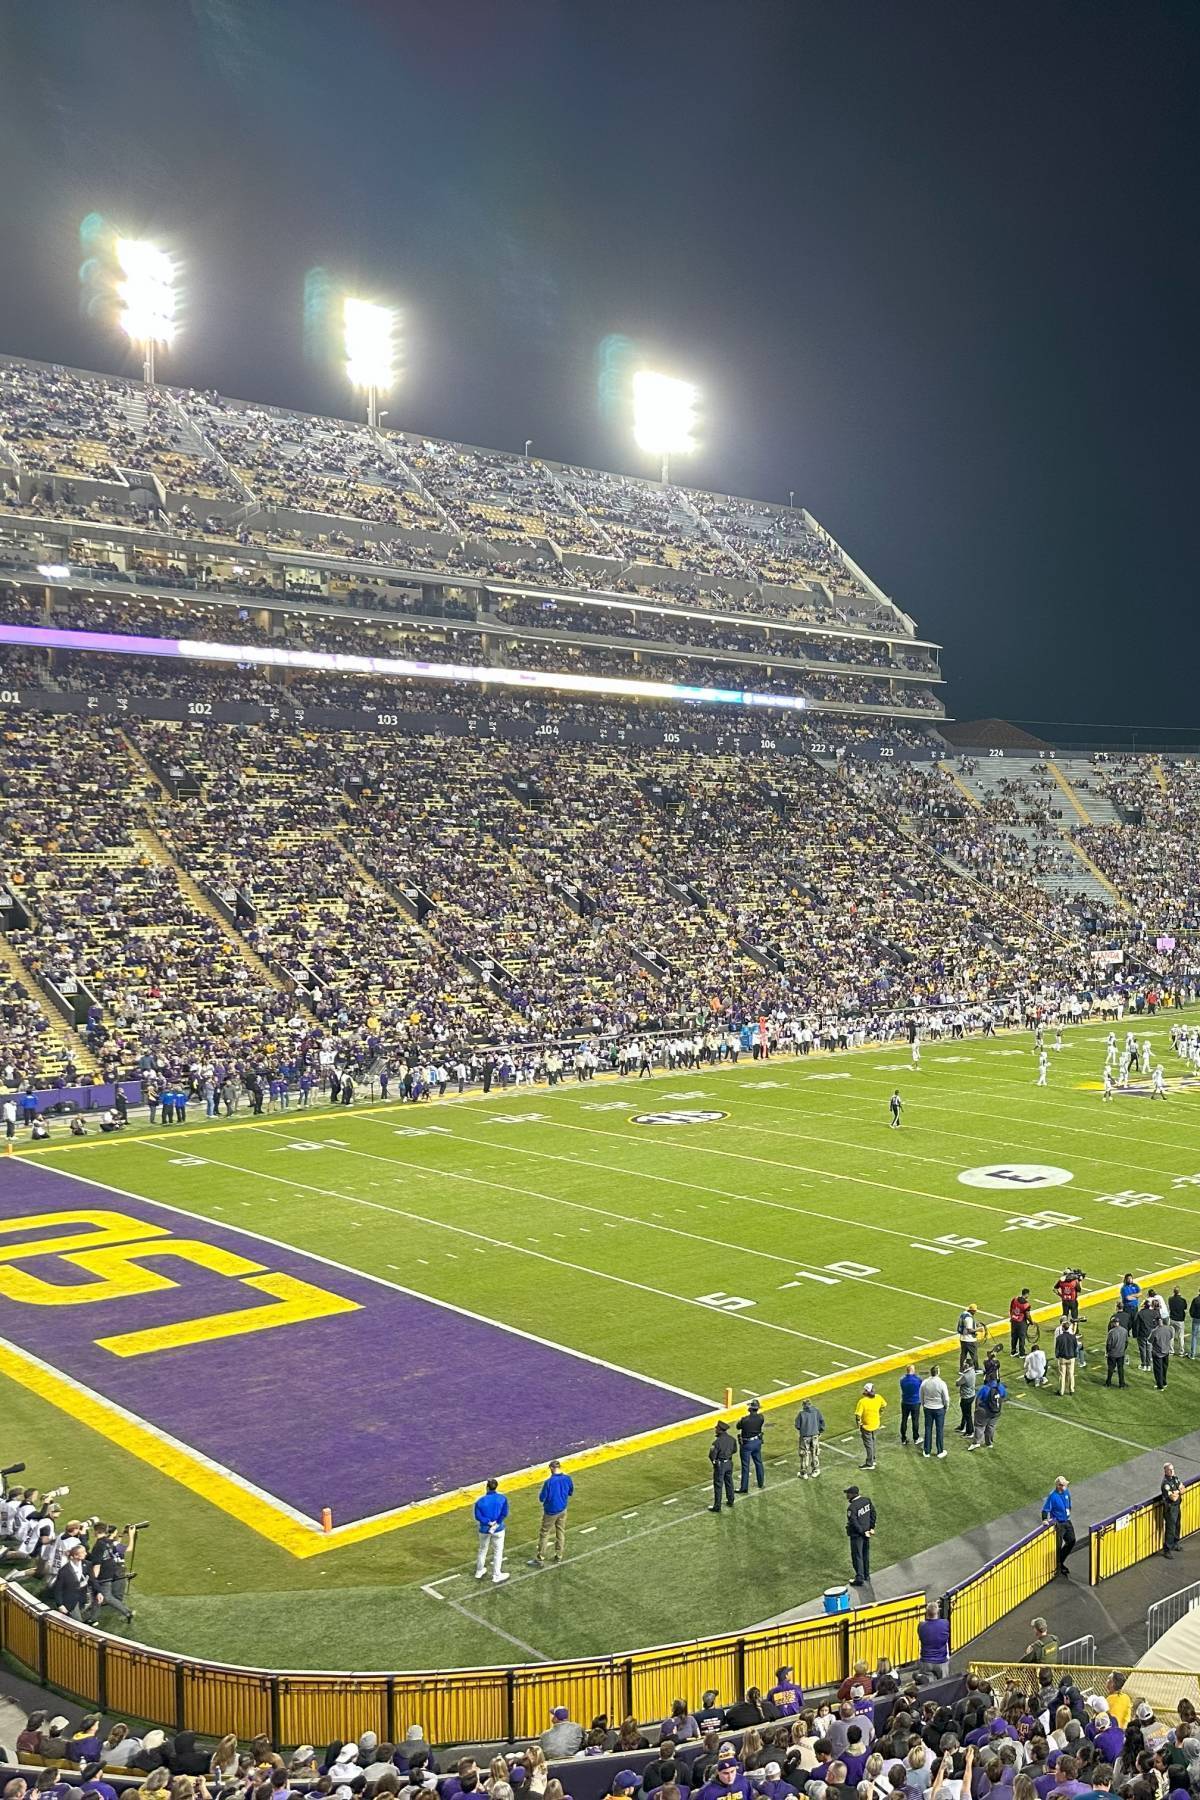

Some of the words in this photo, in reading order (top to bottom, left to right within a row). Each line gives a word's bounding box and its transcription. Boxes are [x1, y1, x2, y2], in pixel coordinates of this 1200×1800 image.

[0, 690, 21, 703] 01
[188, 703, 212, 714] 102
[378, 715, 398, 725] 103
[541, 725, 559, 735] 104
[664, 733, 680, 743] 105
[761, 740, 775, 749] 106
[811, 744, 825, 752] 222
[880, 748, 894, 756] 223
[989, 749, 1003, 757] 224
[1094, 1190, 1165, 1208] 25
[1005, 1210, 1083, 1231] 20
[910, 1233, 988, 1255] 15
[795, 1260, 882, 1285] 10
[0, 1210, 366, 1358] LSU
[695, 1291, 758, 1311] 5
[858, 1504, 871, 1517] POLICE
